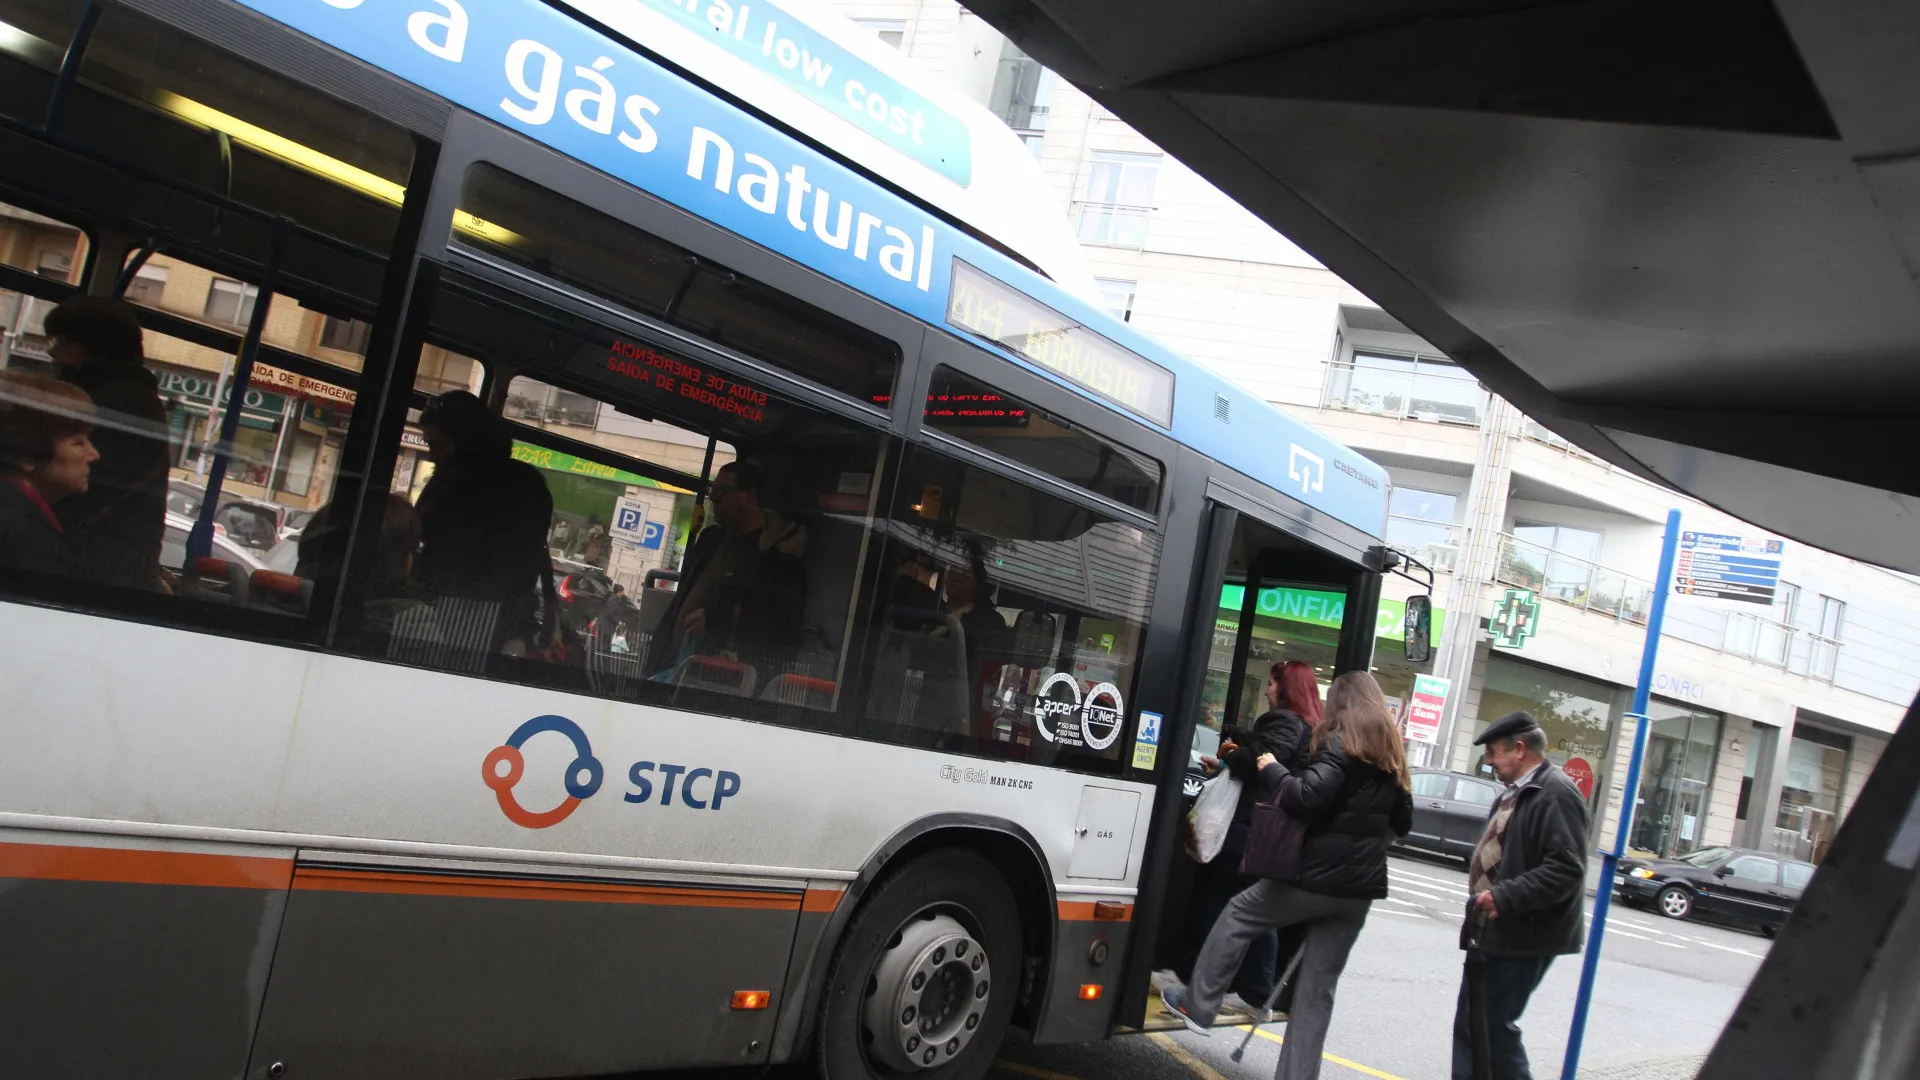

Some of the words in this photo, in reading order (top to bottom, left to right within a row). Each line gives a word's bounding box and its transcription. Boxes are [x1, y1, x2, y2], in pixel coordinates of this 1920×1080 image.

[762, 23, 834, 88] low
[844, 79, 927, 146] cost
[407, 0, 468, 63] a
[499, 38, 661, 154] gás
[686, 124, 934, 292] natural
[251, 363, 274, 378] ÍDA
[280, 372, 294, 384] DE
[299, 378, 357, 402] EMERGÊNC
[607, 357, 649, 383] SAÍDA
[656, 375, 675, 392] DE
[680, 384, 763, 423] EMERGÊNCIA
[1334, 459, 1379, 490] CAETANO
[625, 501, 641, 509] zona
[622, 510, 636, 528] P
[641, 524, 658, 544] P
[1698, 534, 1741, 546] Ermesinde
[1216, 623, 1238, 632] ARMÁC
[1044, 700, 1073, 716] apcer
[1136, 745, 1156, 755] AGENTE
[624, 760, 741, 811] STCP
[940, 764, 962, 783] City
[964, 768, 989, 784] Gold
[990, 776, 1007, 787] MAN
[1008, 778, 1018, 788] 2K
[1018, 780, 1033, 790] CNG
